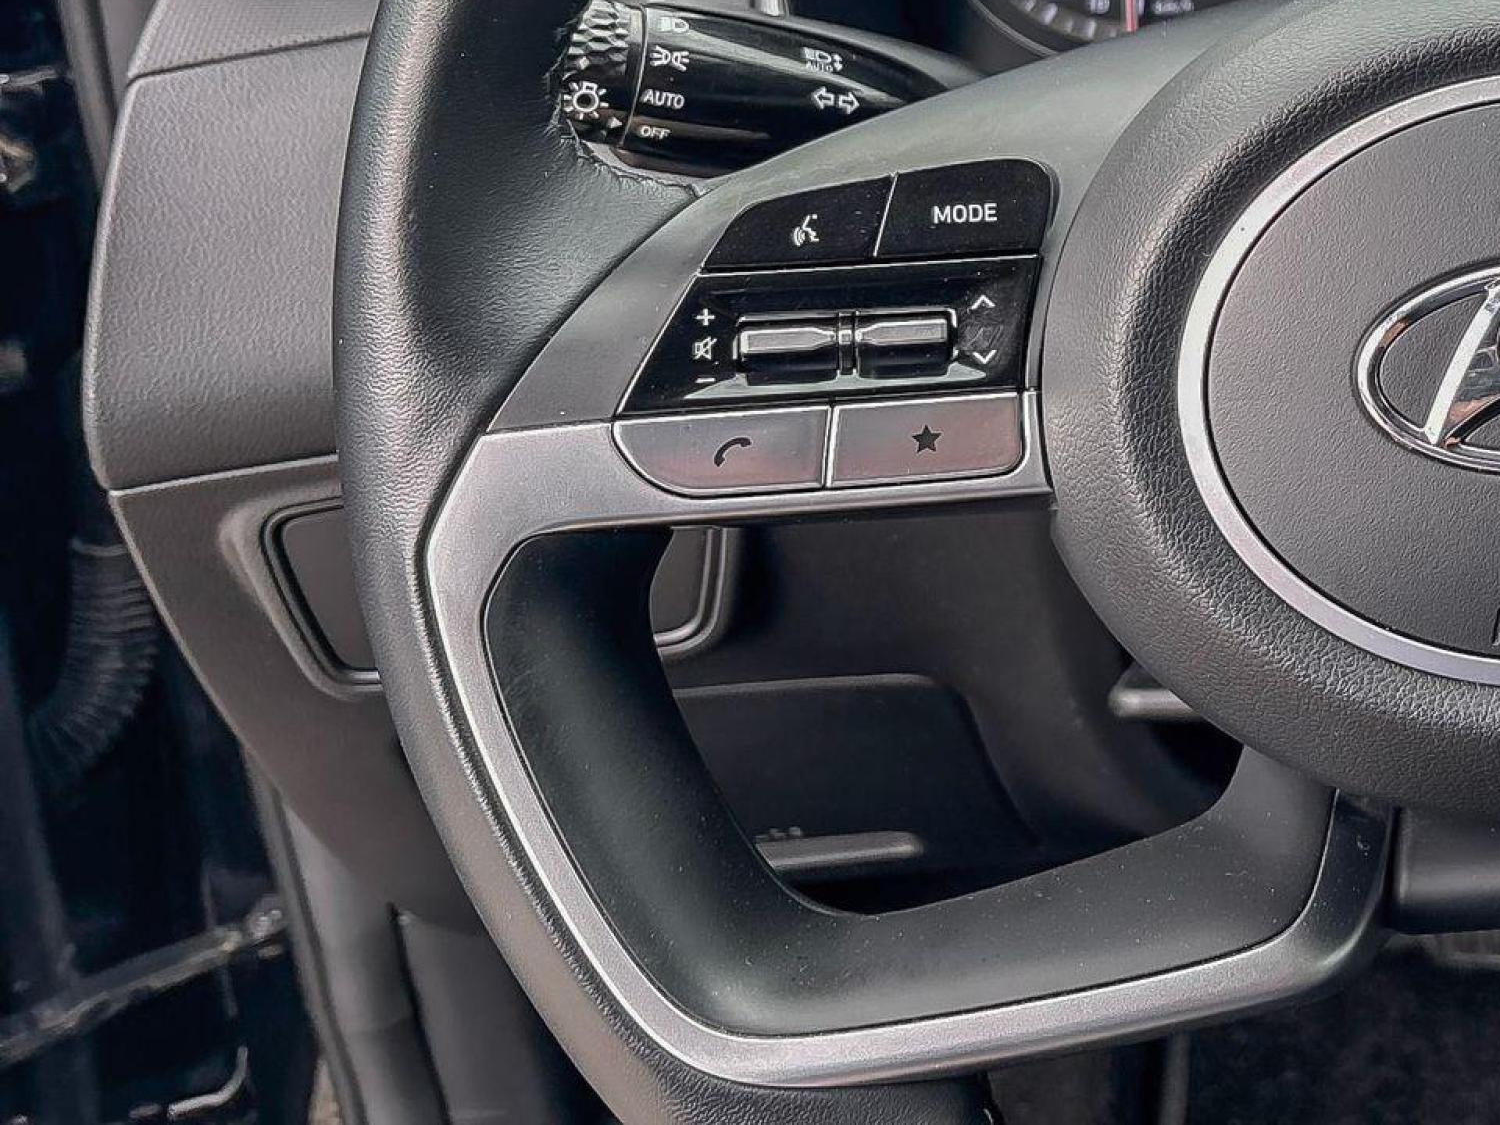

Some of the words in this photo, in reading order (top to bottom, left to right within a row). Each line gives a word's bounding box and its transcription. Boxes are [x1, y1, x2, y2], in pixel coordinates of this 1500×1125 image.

[641, 88, 686, 110] AUTO
[640, 125, 671, 140] OFF
[932, 202, 998, 224] MODE
